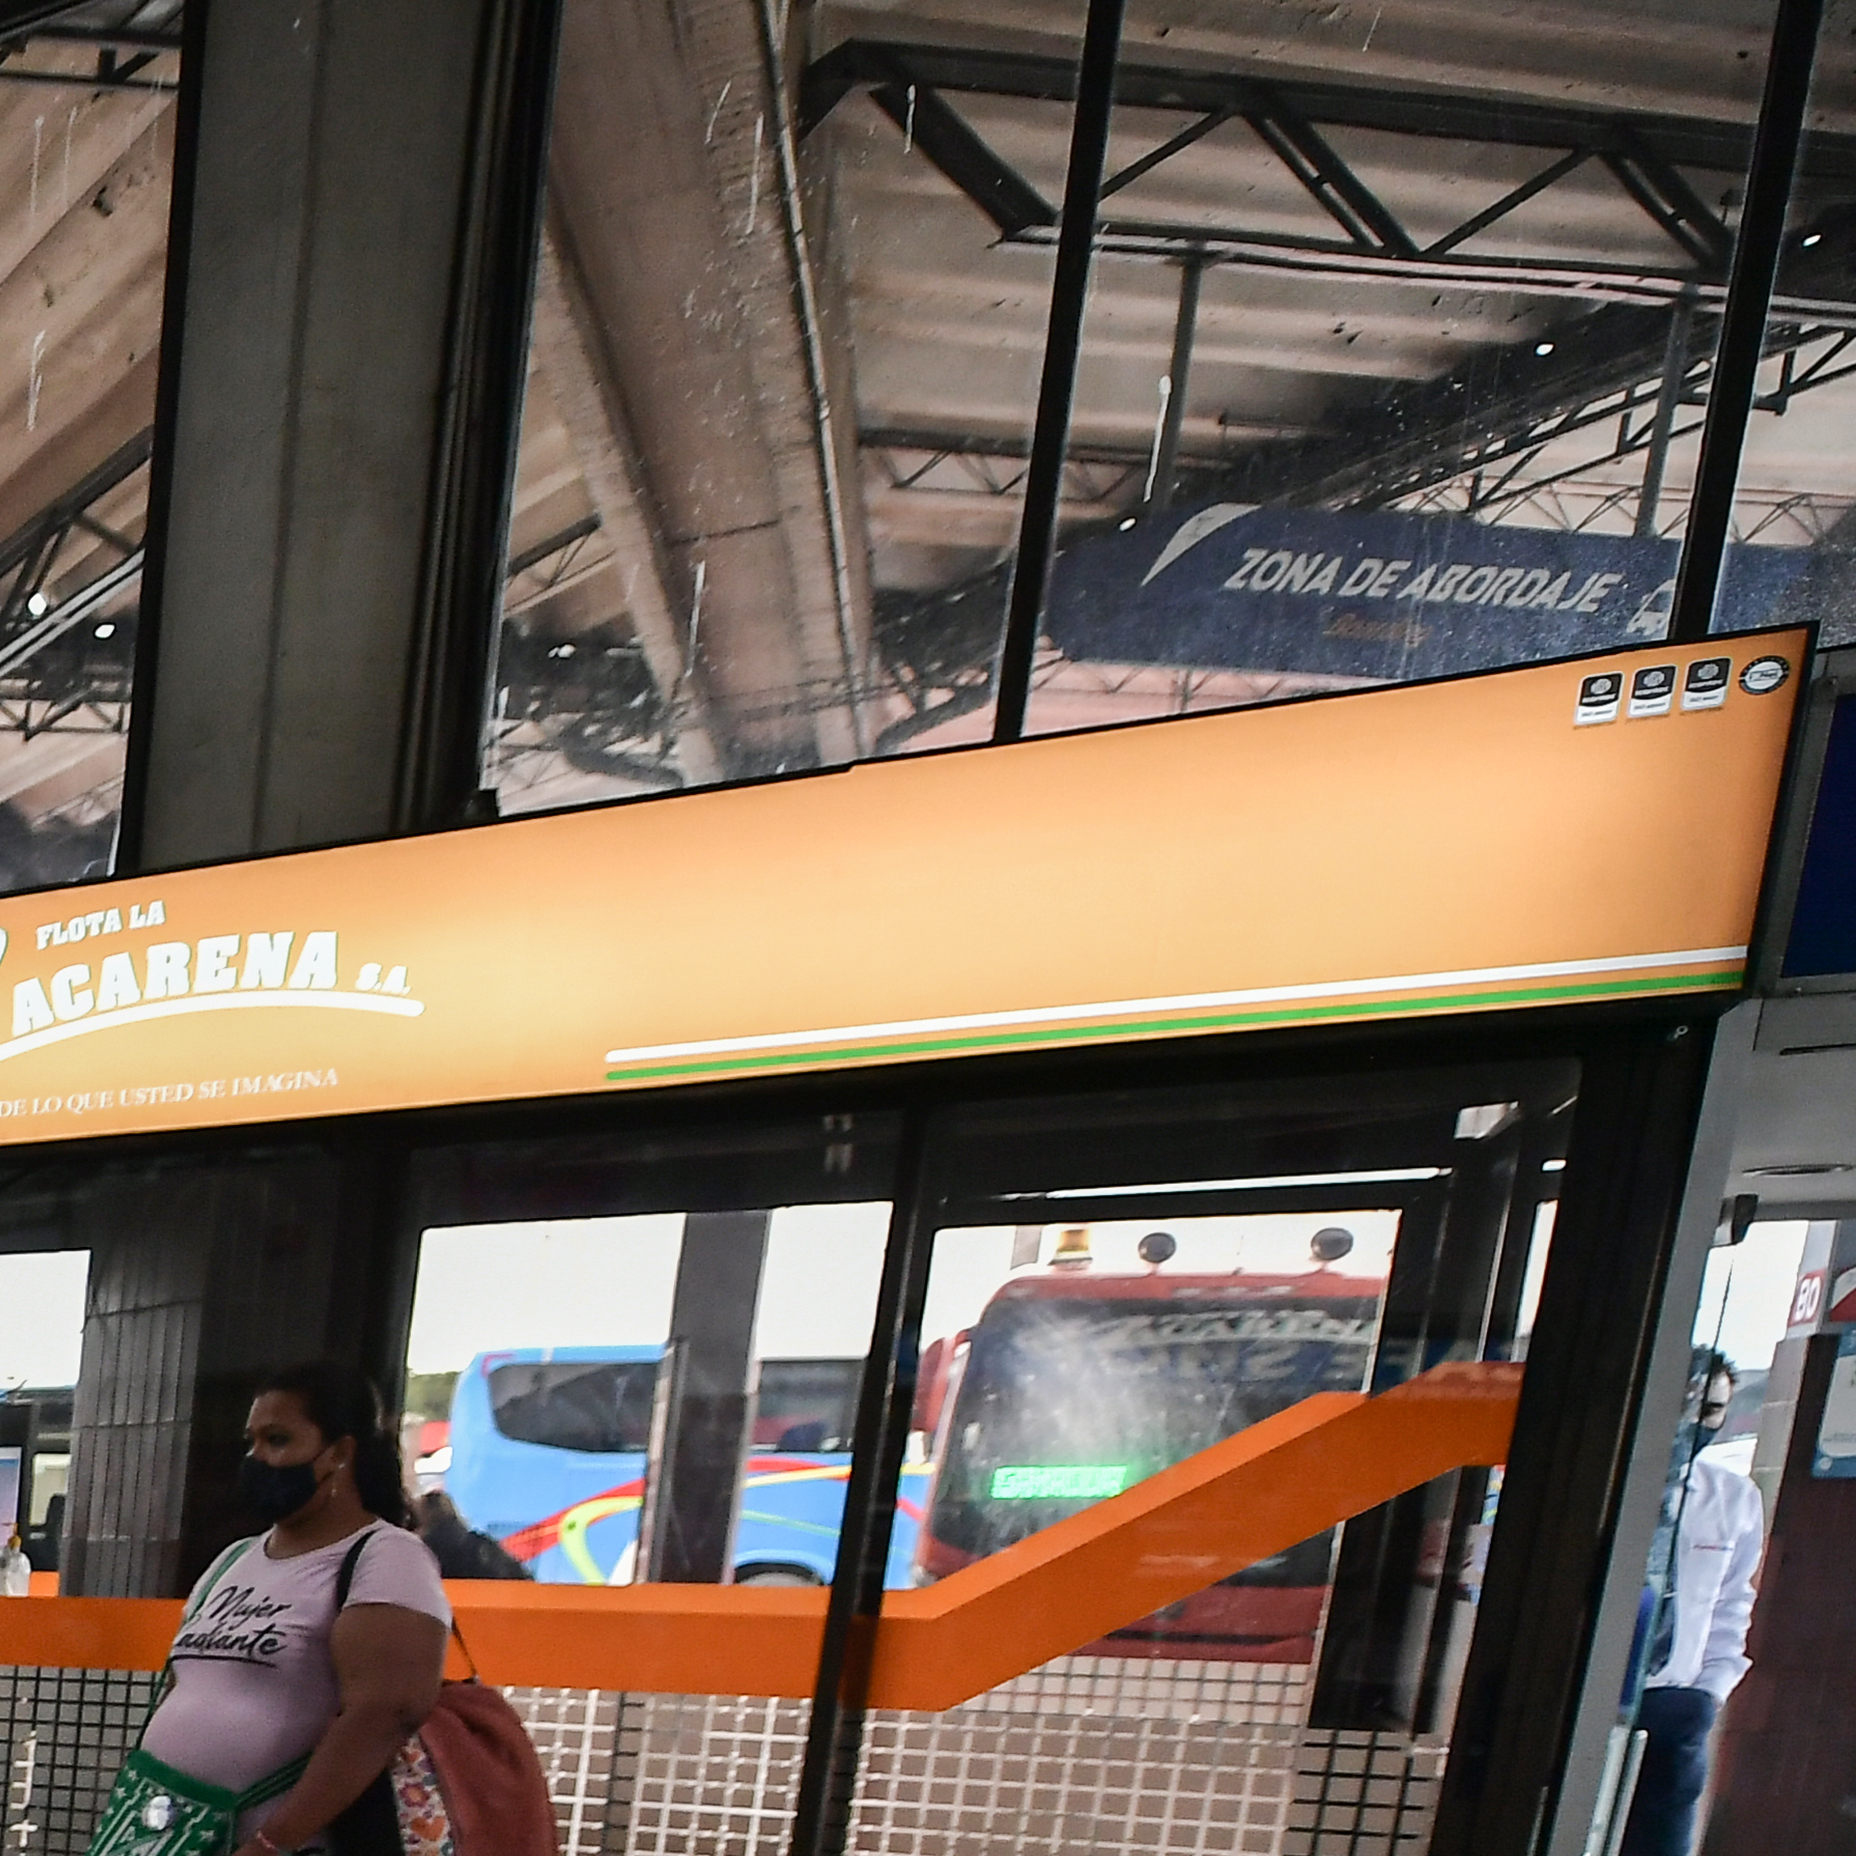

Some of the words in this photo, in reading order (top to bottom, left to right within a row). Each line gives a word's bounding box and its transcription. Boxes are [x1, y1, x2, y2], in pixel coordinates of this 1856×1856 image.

[1224, 548, 1343, 596] ZONA
[1338, 558, 1412, 597] DE
[1396, 563, 1625, 613] ABORDAJE
[35, 910, 123, 951] FLOTA
[129, 900, 167, 930] LA
[31, 1096, 63, 1116] LO
[66, 1092, 114, 1117] QUE
[119, 1083, 195, 1108] USTED
[198, 1081, 226, 1099] SE
[232, 1068, 339, 1096] IMAGINA
[1794, 1276, 1821, 1321] 80
[207, 1586, 292, 1631] Mujer
